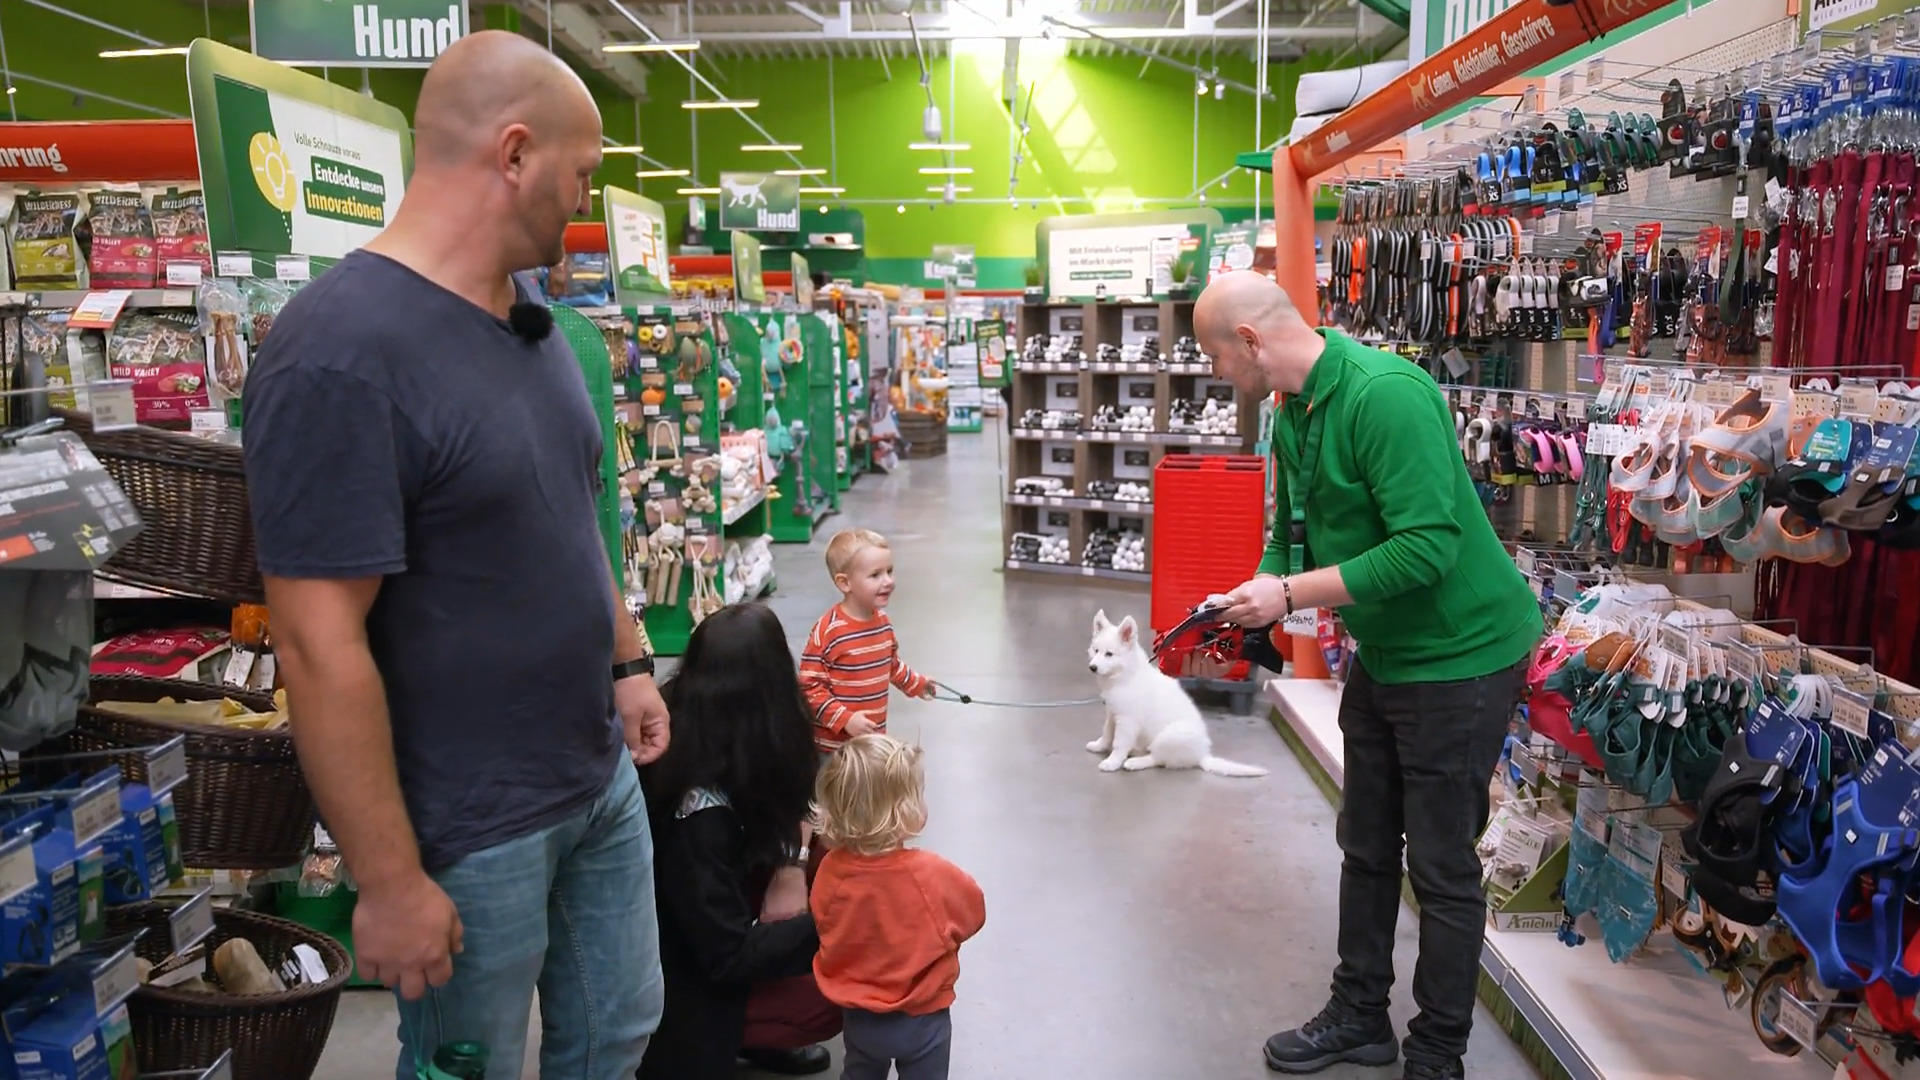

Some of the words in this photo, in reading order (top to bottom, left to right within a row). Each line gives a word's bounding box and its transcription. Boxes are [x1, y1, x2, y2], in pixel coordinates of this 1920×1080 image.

[353, 5, 459, 58] Hund
[1500, 14, 1556, 58] Geschirre
[314, 162, 360, 190] Entdecke
[306, 188, 383, 221] Innovationen
[757, 208, 797, 228] Hund
[112, 367, 131, 377] WILD
